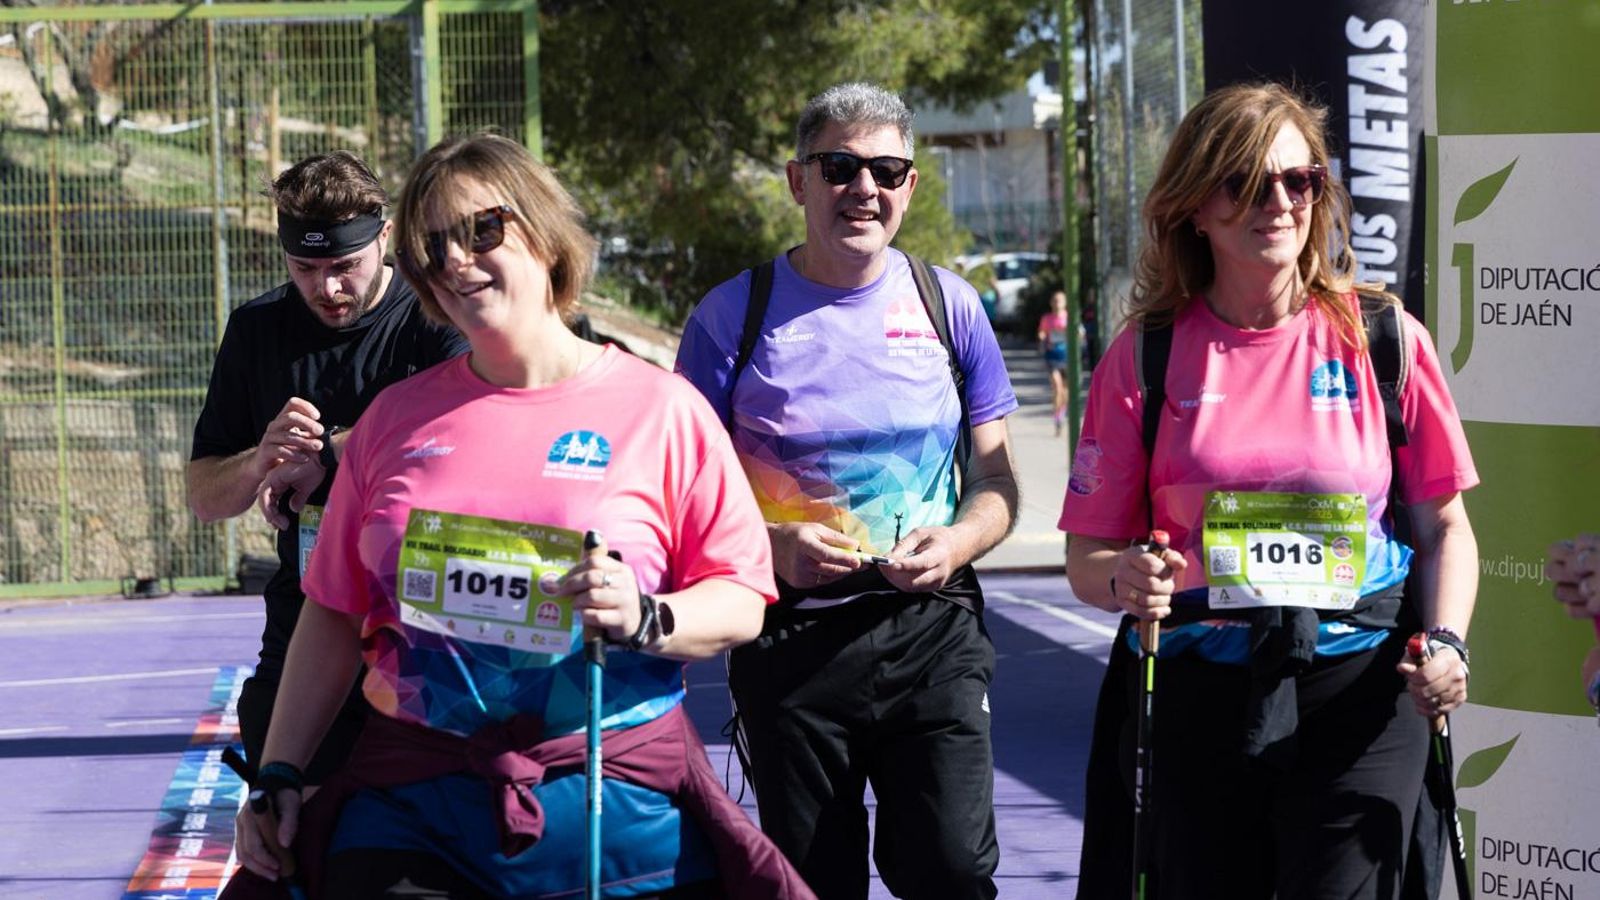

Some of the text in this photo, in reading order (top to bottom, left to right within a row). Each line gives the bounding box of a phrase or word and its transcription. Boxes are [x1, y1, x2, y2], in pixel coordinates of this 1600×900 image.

[1345, 15, 1410, 202] METAS
[1481, 299, 1572, 326] DE JAÉN
[1250, 542, 1323, 565] 1016
[447, 569, 528, 600] 1015
[1482, 871, 1509, 898] DE
